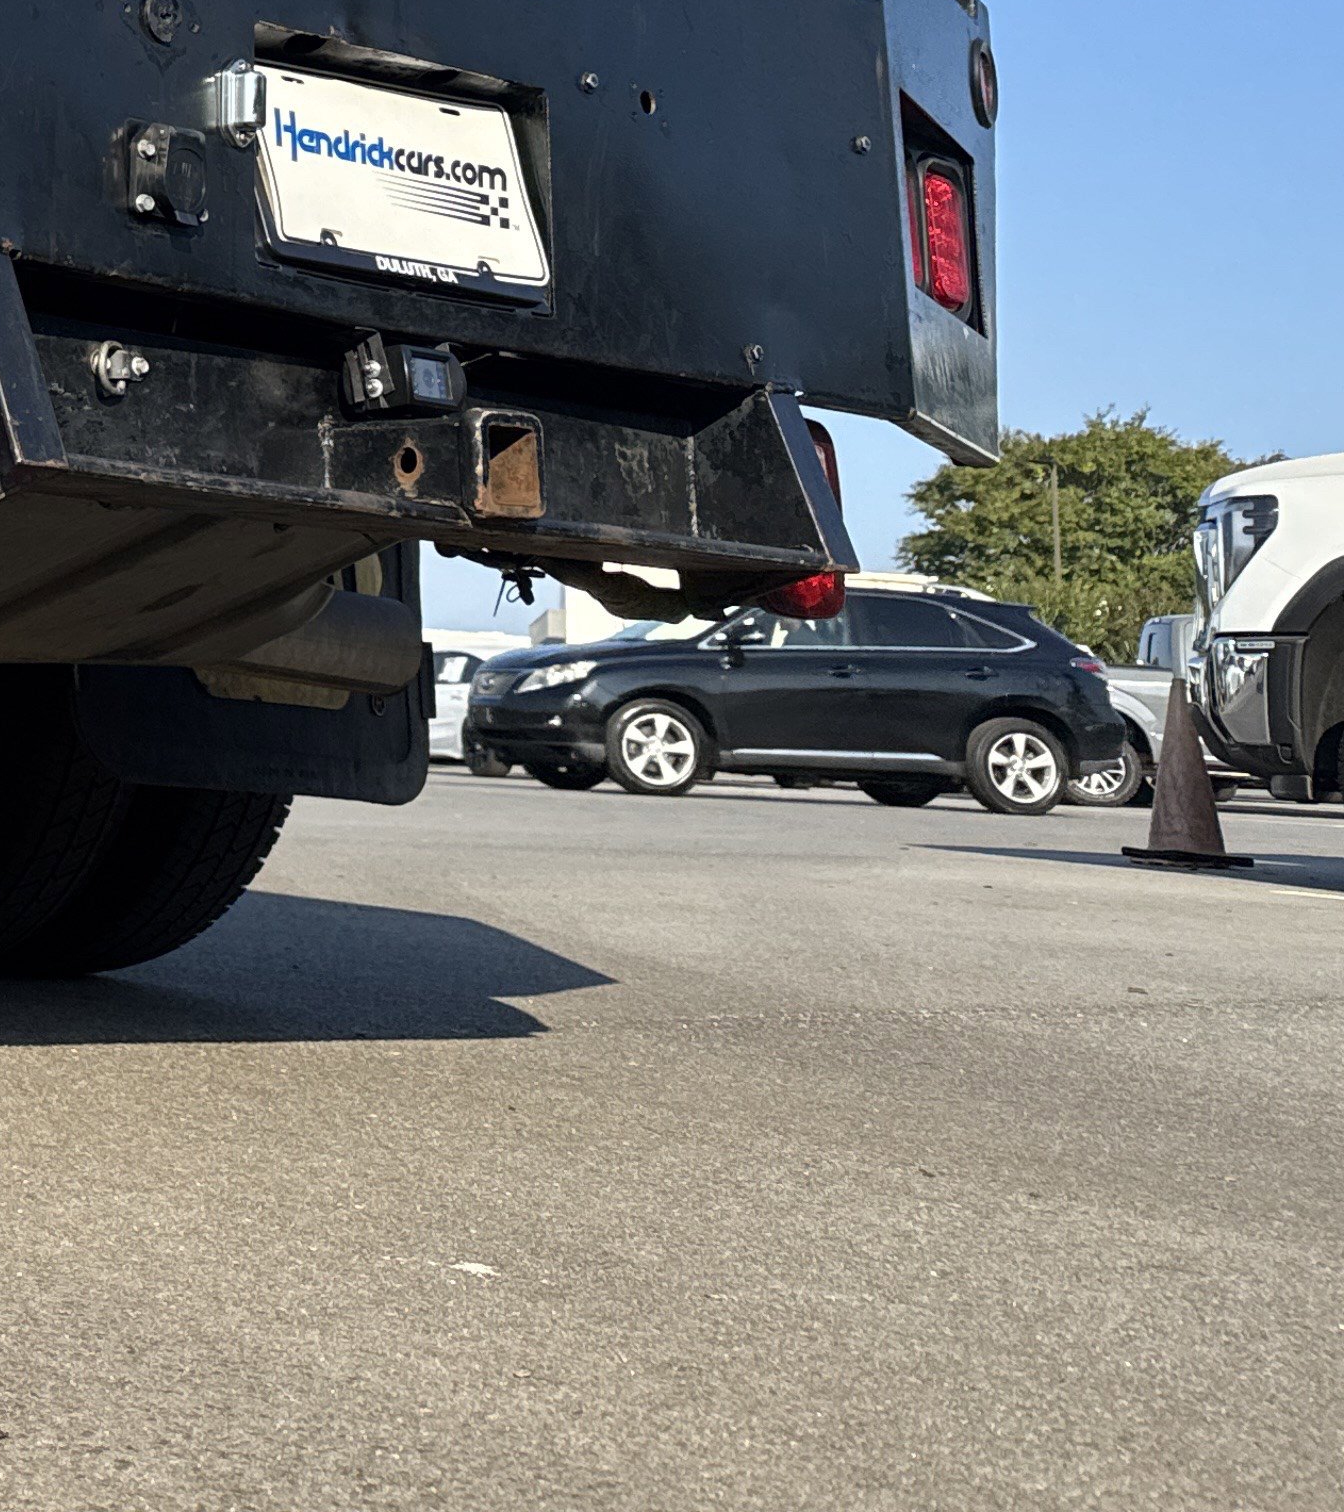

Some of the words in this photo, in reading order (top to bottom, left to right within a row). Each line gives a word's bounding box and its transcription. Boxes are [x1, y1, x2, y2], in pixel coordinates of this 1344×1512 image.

[273, 107, 507, 192] Hendrickcars.com
[375, 255, 437, 282] DULUTH,
[436, 267, 459, 284] GA
